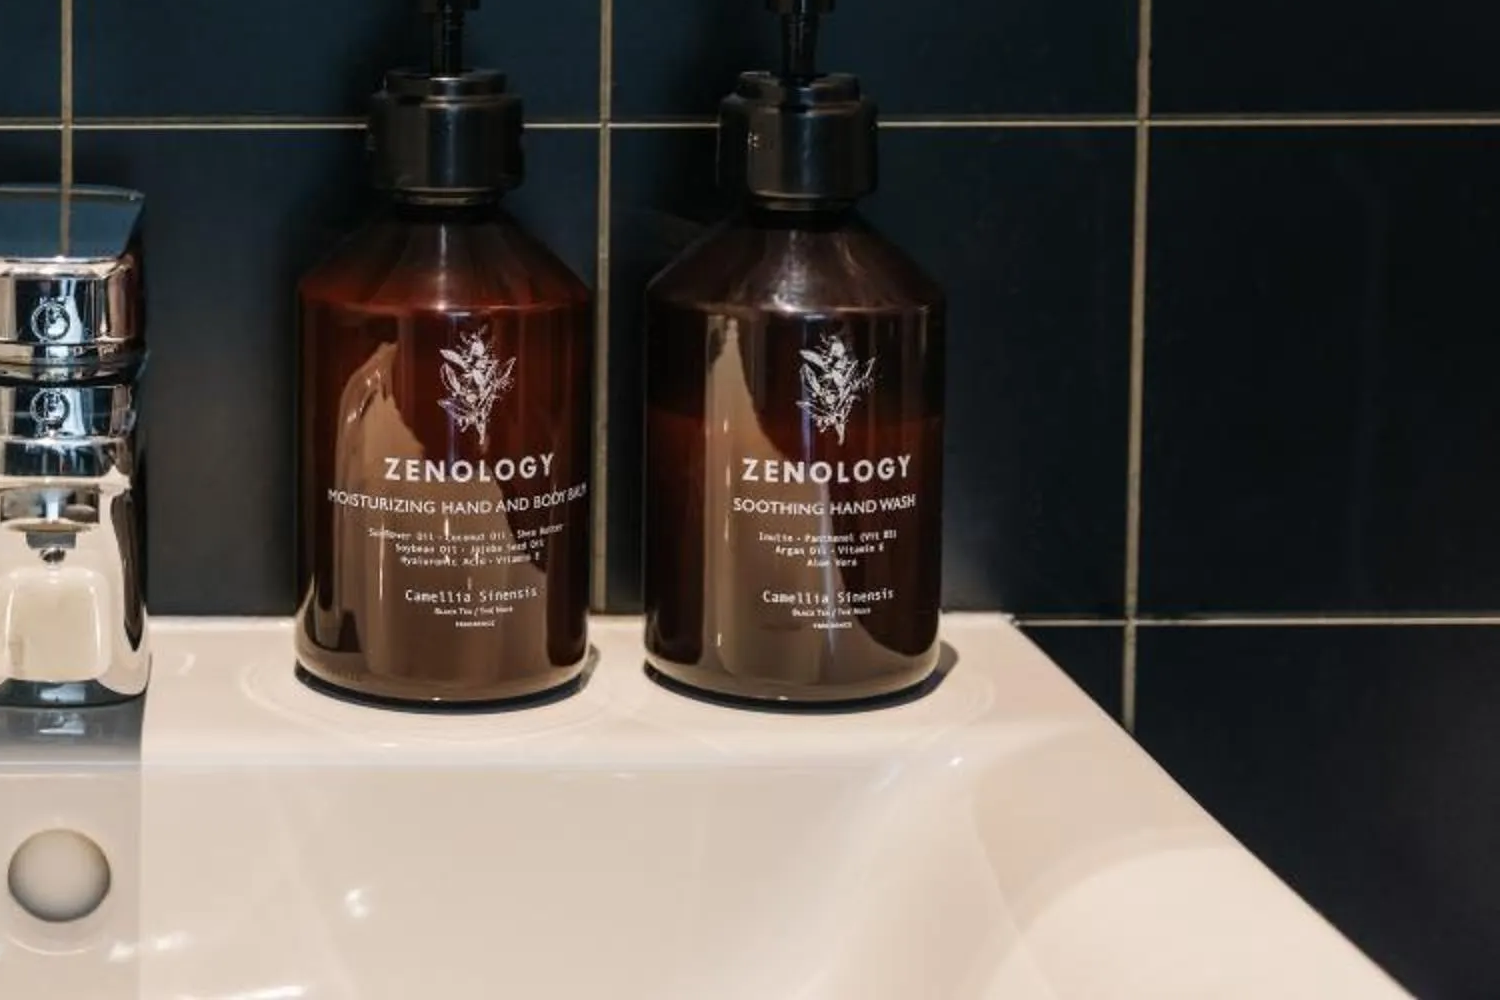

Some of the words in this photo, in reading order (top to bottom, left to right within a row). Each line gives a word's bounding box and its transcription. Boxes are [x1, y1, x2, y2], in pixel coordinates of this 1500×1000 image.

[384, 453, 554, 483] ZENOLOGY
[741, 453, 912, 484] ZENOLOGY
[328, 488, 436, 514] MOISTURIZING
[441, 499, 492, 515] HAND
[495, 496, 529, 512] AND
[533, 488, 566, 509] BODY
[733, 497, 825, 516] SOOTHING
[829, 500, 877, 515] HAND
[879, 494, 916, 511] WASH
[416, 532, 433, 541] Oil
[489, 530, 506, 540] Oil
[439, 544, 457, 555] Oil
[405, 589, 471, 604] Camellia
[479, 587, 538, 602] Sinensis
[762, 590, 829, 604] Camellia
[837, 588, 895, 603] Sinensis
